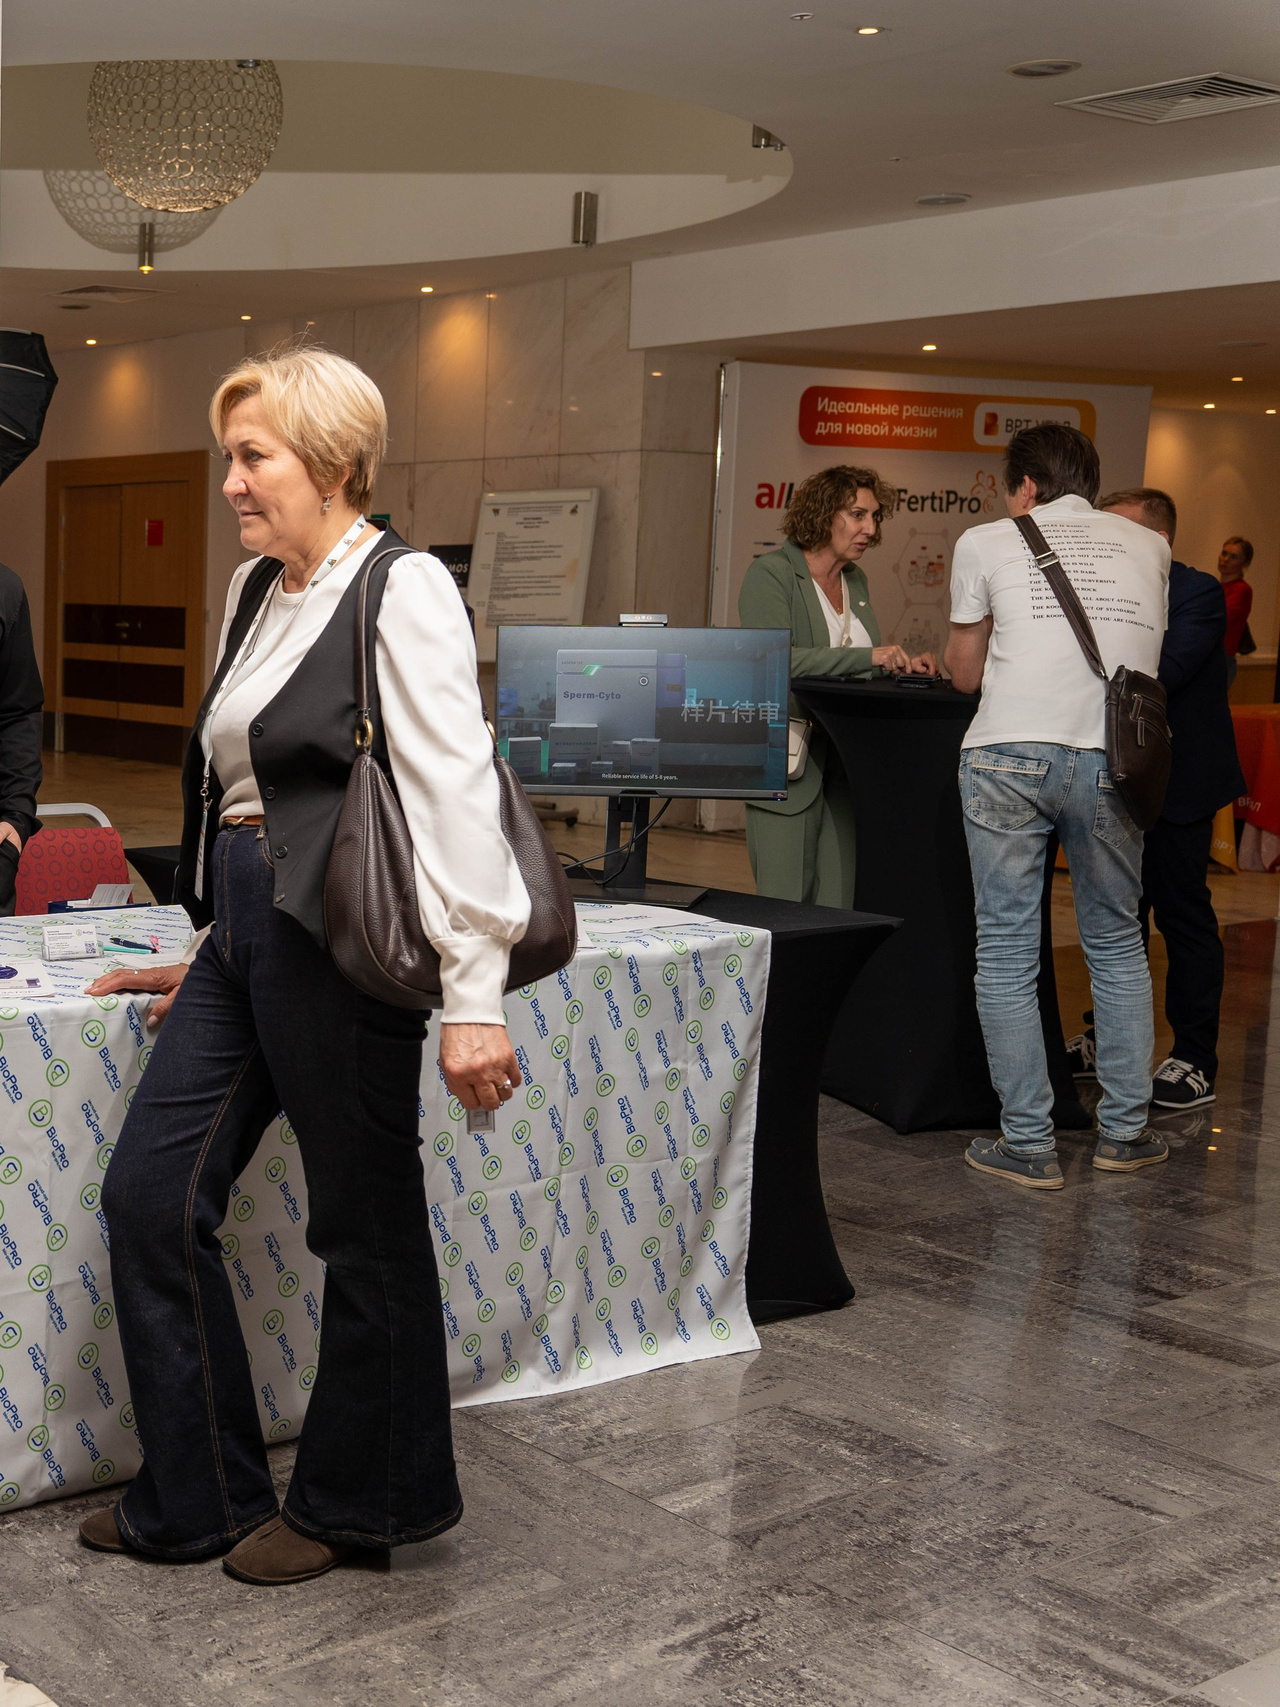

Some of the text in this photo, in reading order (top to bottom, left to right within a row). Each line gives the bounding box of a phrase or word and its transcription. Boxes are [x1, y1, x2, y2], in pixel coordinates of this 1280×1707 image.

[816, 397, 964, 420] Идеальные решения
[815, 420, 938, 438] для новой жизни
[563, 691, 621, 701] Sperm-Cyto
[680, 699, 780, 724] 样片待审
